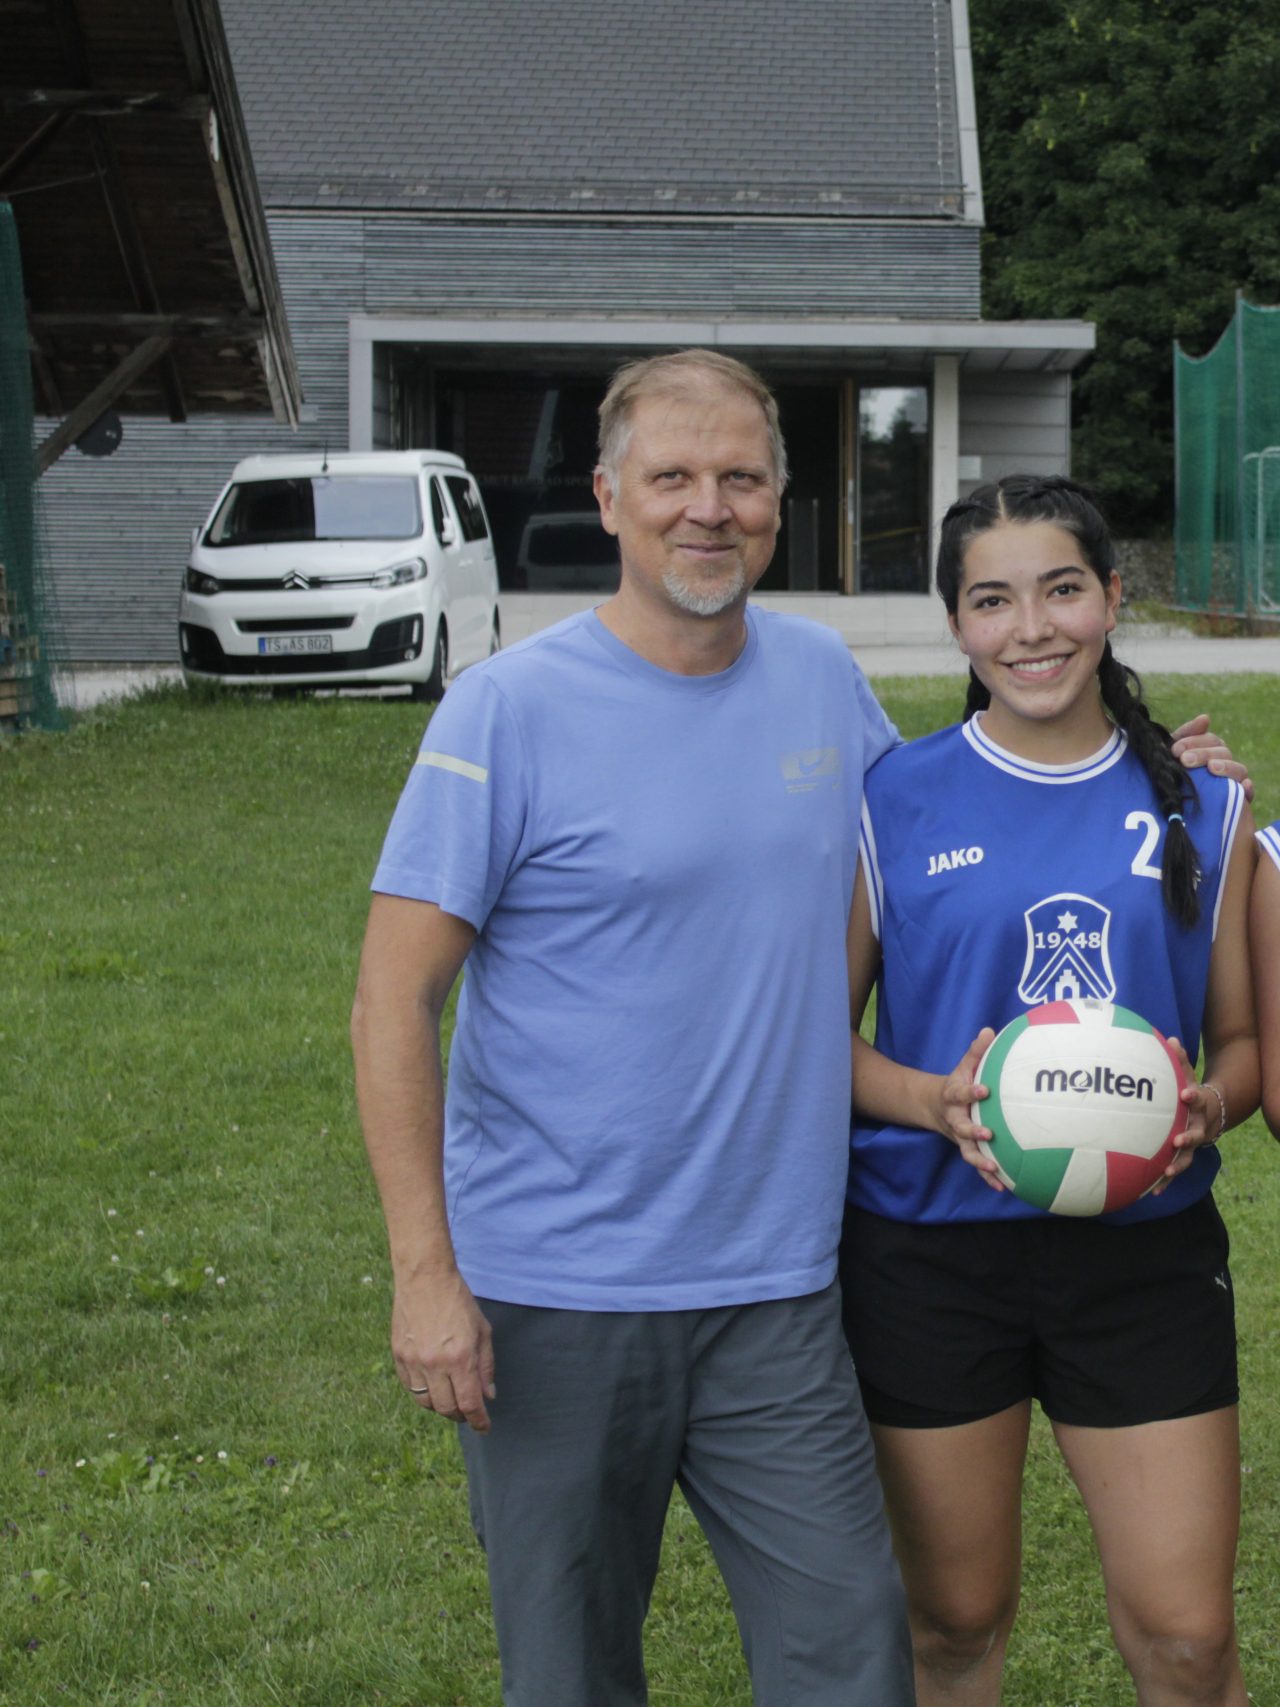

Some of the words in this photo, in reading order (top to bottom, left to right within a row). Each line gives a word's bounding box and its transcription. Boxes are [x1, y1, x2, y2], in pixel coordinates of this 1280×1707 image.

[289, 638, 305, 651] AS
[926, 846, 984, 876] JAKO
[1034, 932, 1061, 949] 19
[1073, 932, 1102, 949] 48
[1034, 1066, 1154, 1102] molten
